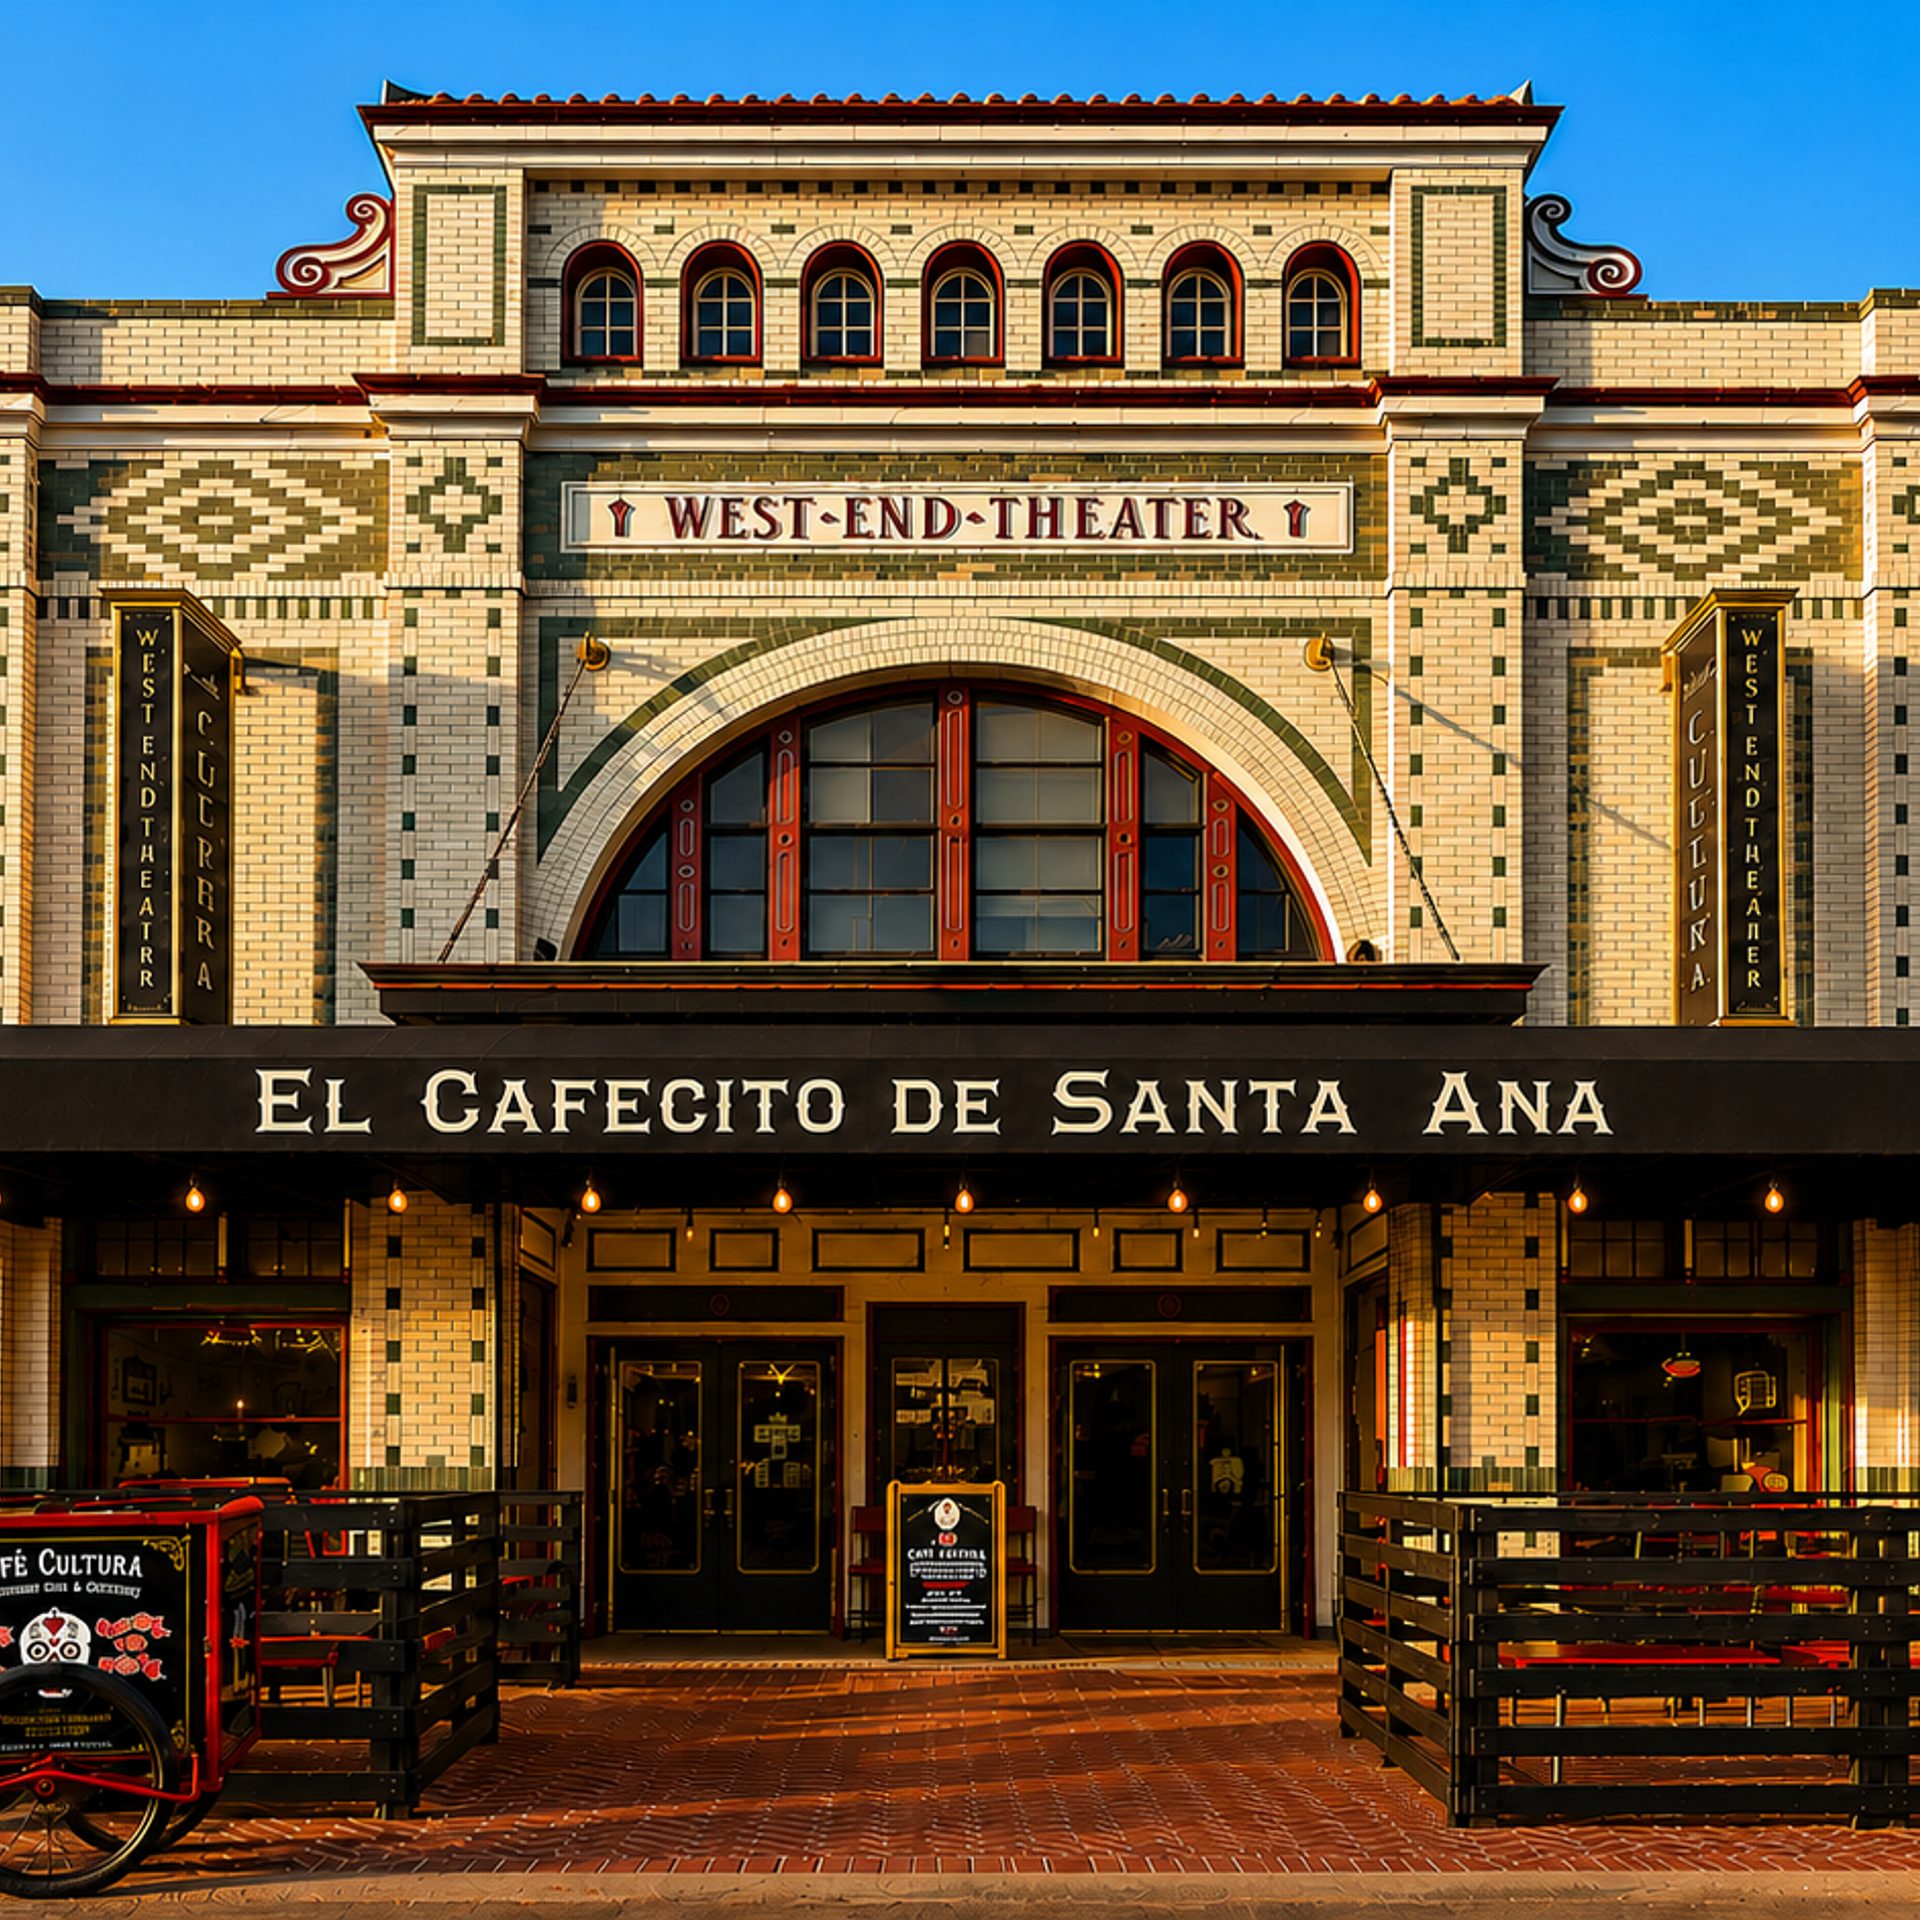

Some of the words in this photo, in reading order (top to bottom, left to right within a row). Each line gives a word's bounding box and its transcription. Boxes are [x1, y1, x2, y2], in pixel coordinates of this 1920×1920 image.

[665, 496, 817, 541] WEST
[842, 496, 961, 541] END
[989, 496, 1263, 541] THEATER
[136, 628, 159, 725] WEST
[1741, 629, 1763, 725] WEST
[420, 1069, 845, 1134] CAFECITO
[891, 1079, 1001, 1134] DE
[1051, 1069, 1357, 1135] SANTA
[1422, 1071, 1613, 1135] ANA
[38, 1547, 143, 1578] CULTURA
